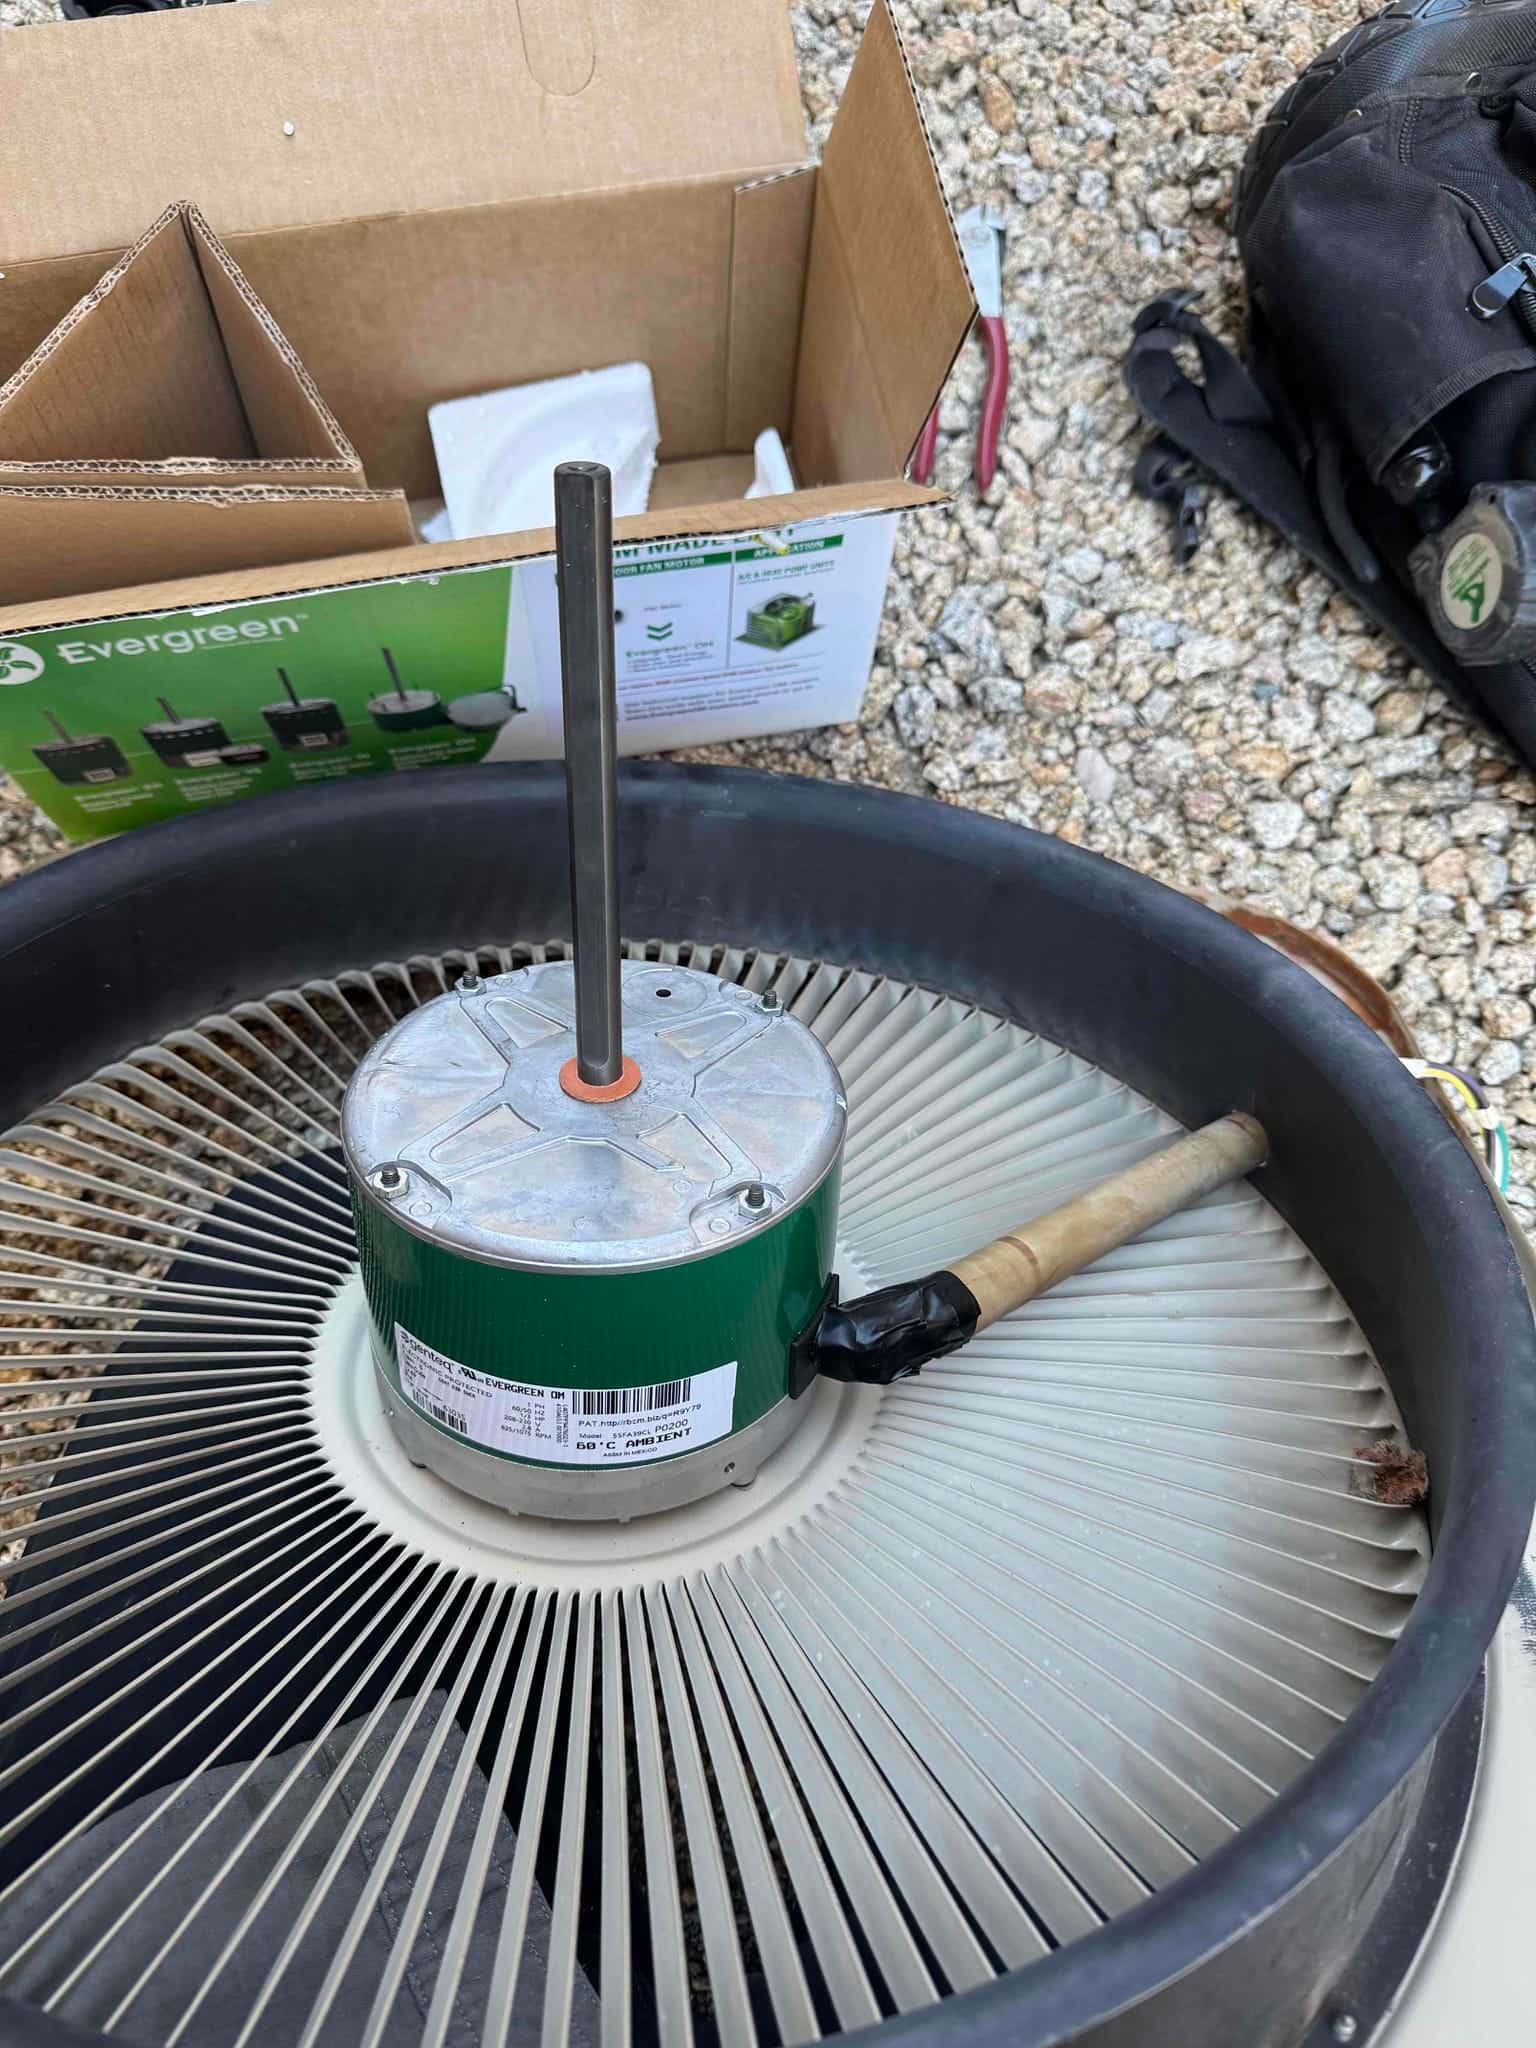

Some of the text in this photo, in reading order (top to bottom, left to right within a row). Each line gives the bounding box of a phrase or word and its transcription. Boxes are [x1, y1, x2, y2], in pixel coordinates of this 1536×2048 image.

[640, 562, 662, 573] FAN
[664, 557, 705, 570] MOTOR
[57, 613, 300, 664] Evergreen
[485, 1377, 545, 1398] EVERGREEN
[535, 1432, 552, 1440] RPM
[626, 1426, 692, 1448] AMBIENT
